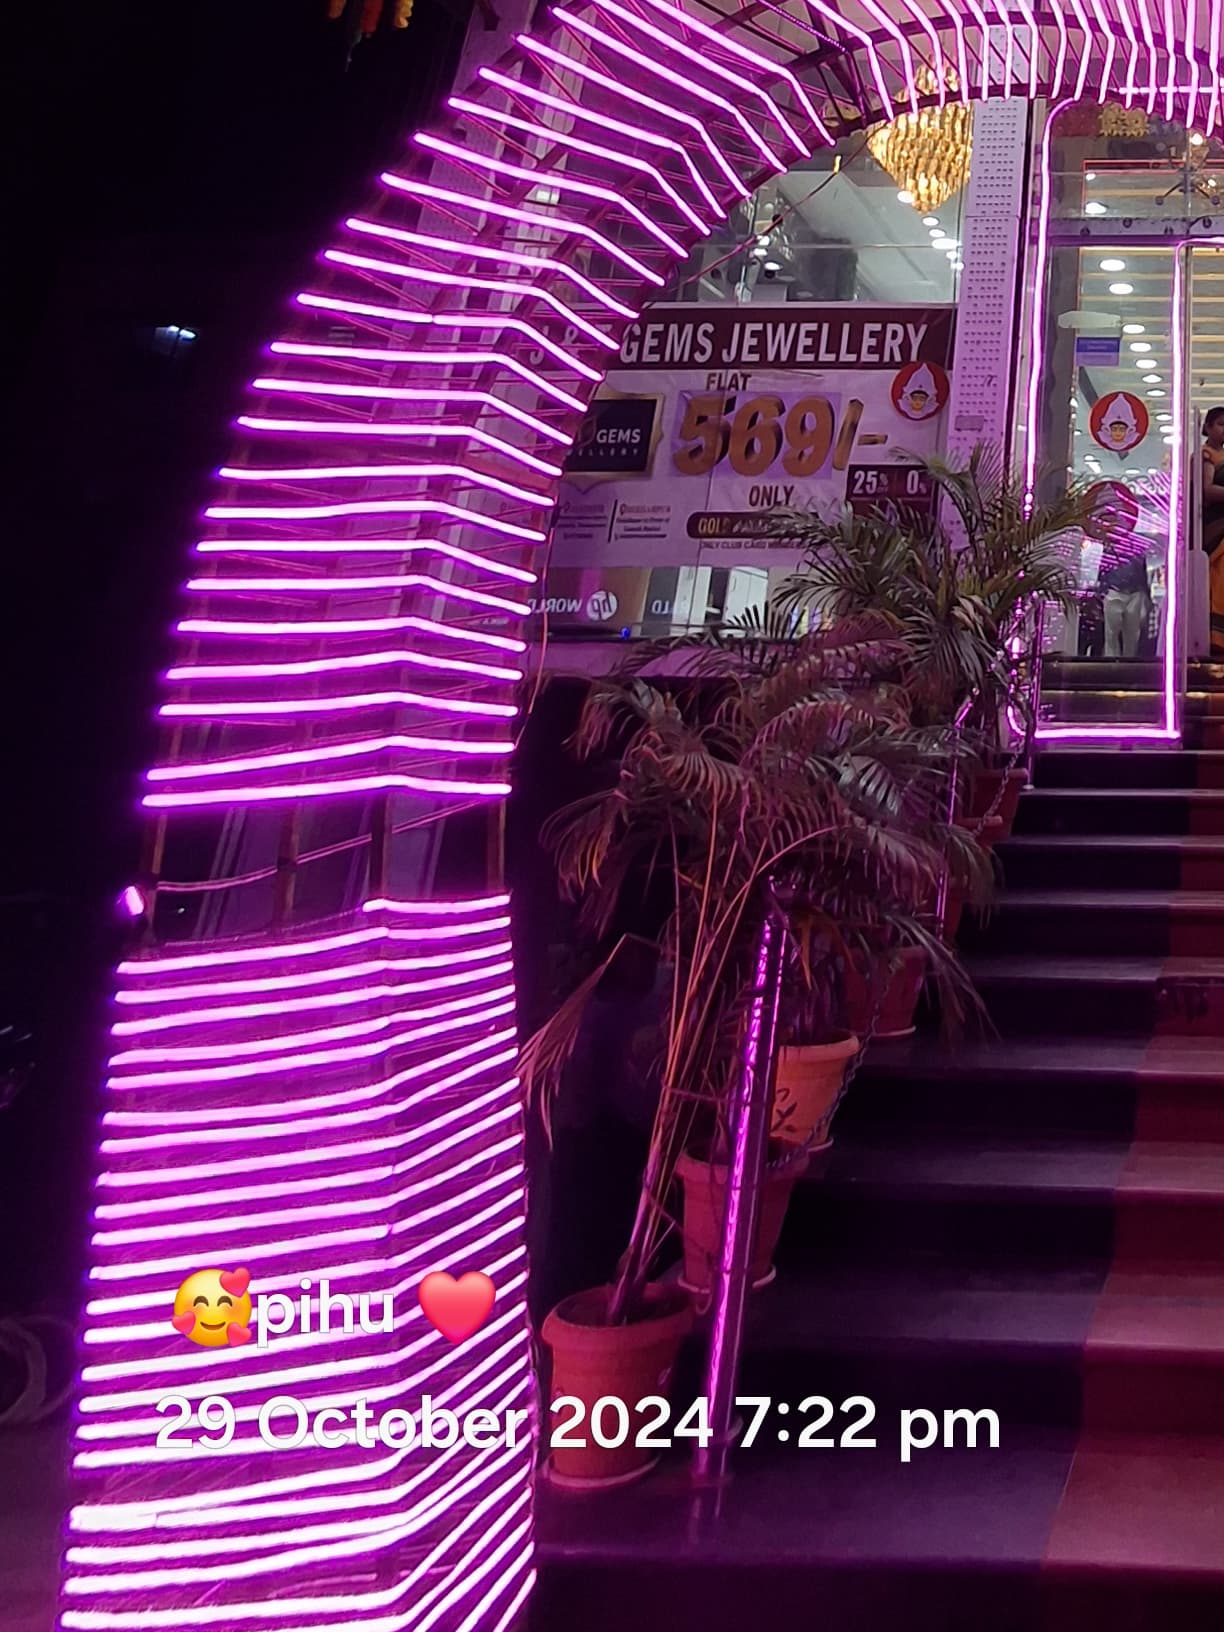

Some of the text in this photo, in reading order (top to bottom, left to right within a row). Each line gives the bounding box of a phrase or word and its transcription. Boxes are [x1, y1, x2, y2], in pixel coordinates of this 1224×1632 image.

[619, 321, 715, 364] GEMS
[721, 321, 929, 364] JEWELLERY
[705, 372, 752, 391] FLAT
[596, 428, 641, 444] GEMS
[749, 484, 795, 508] ONLY
